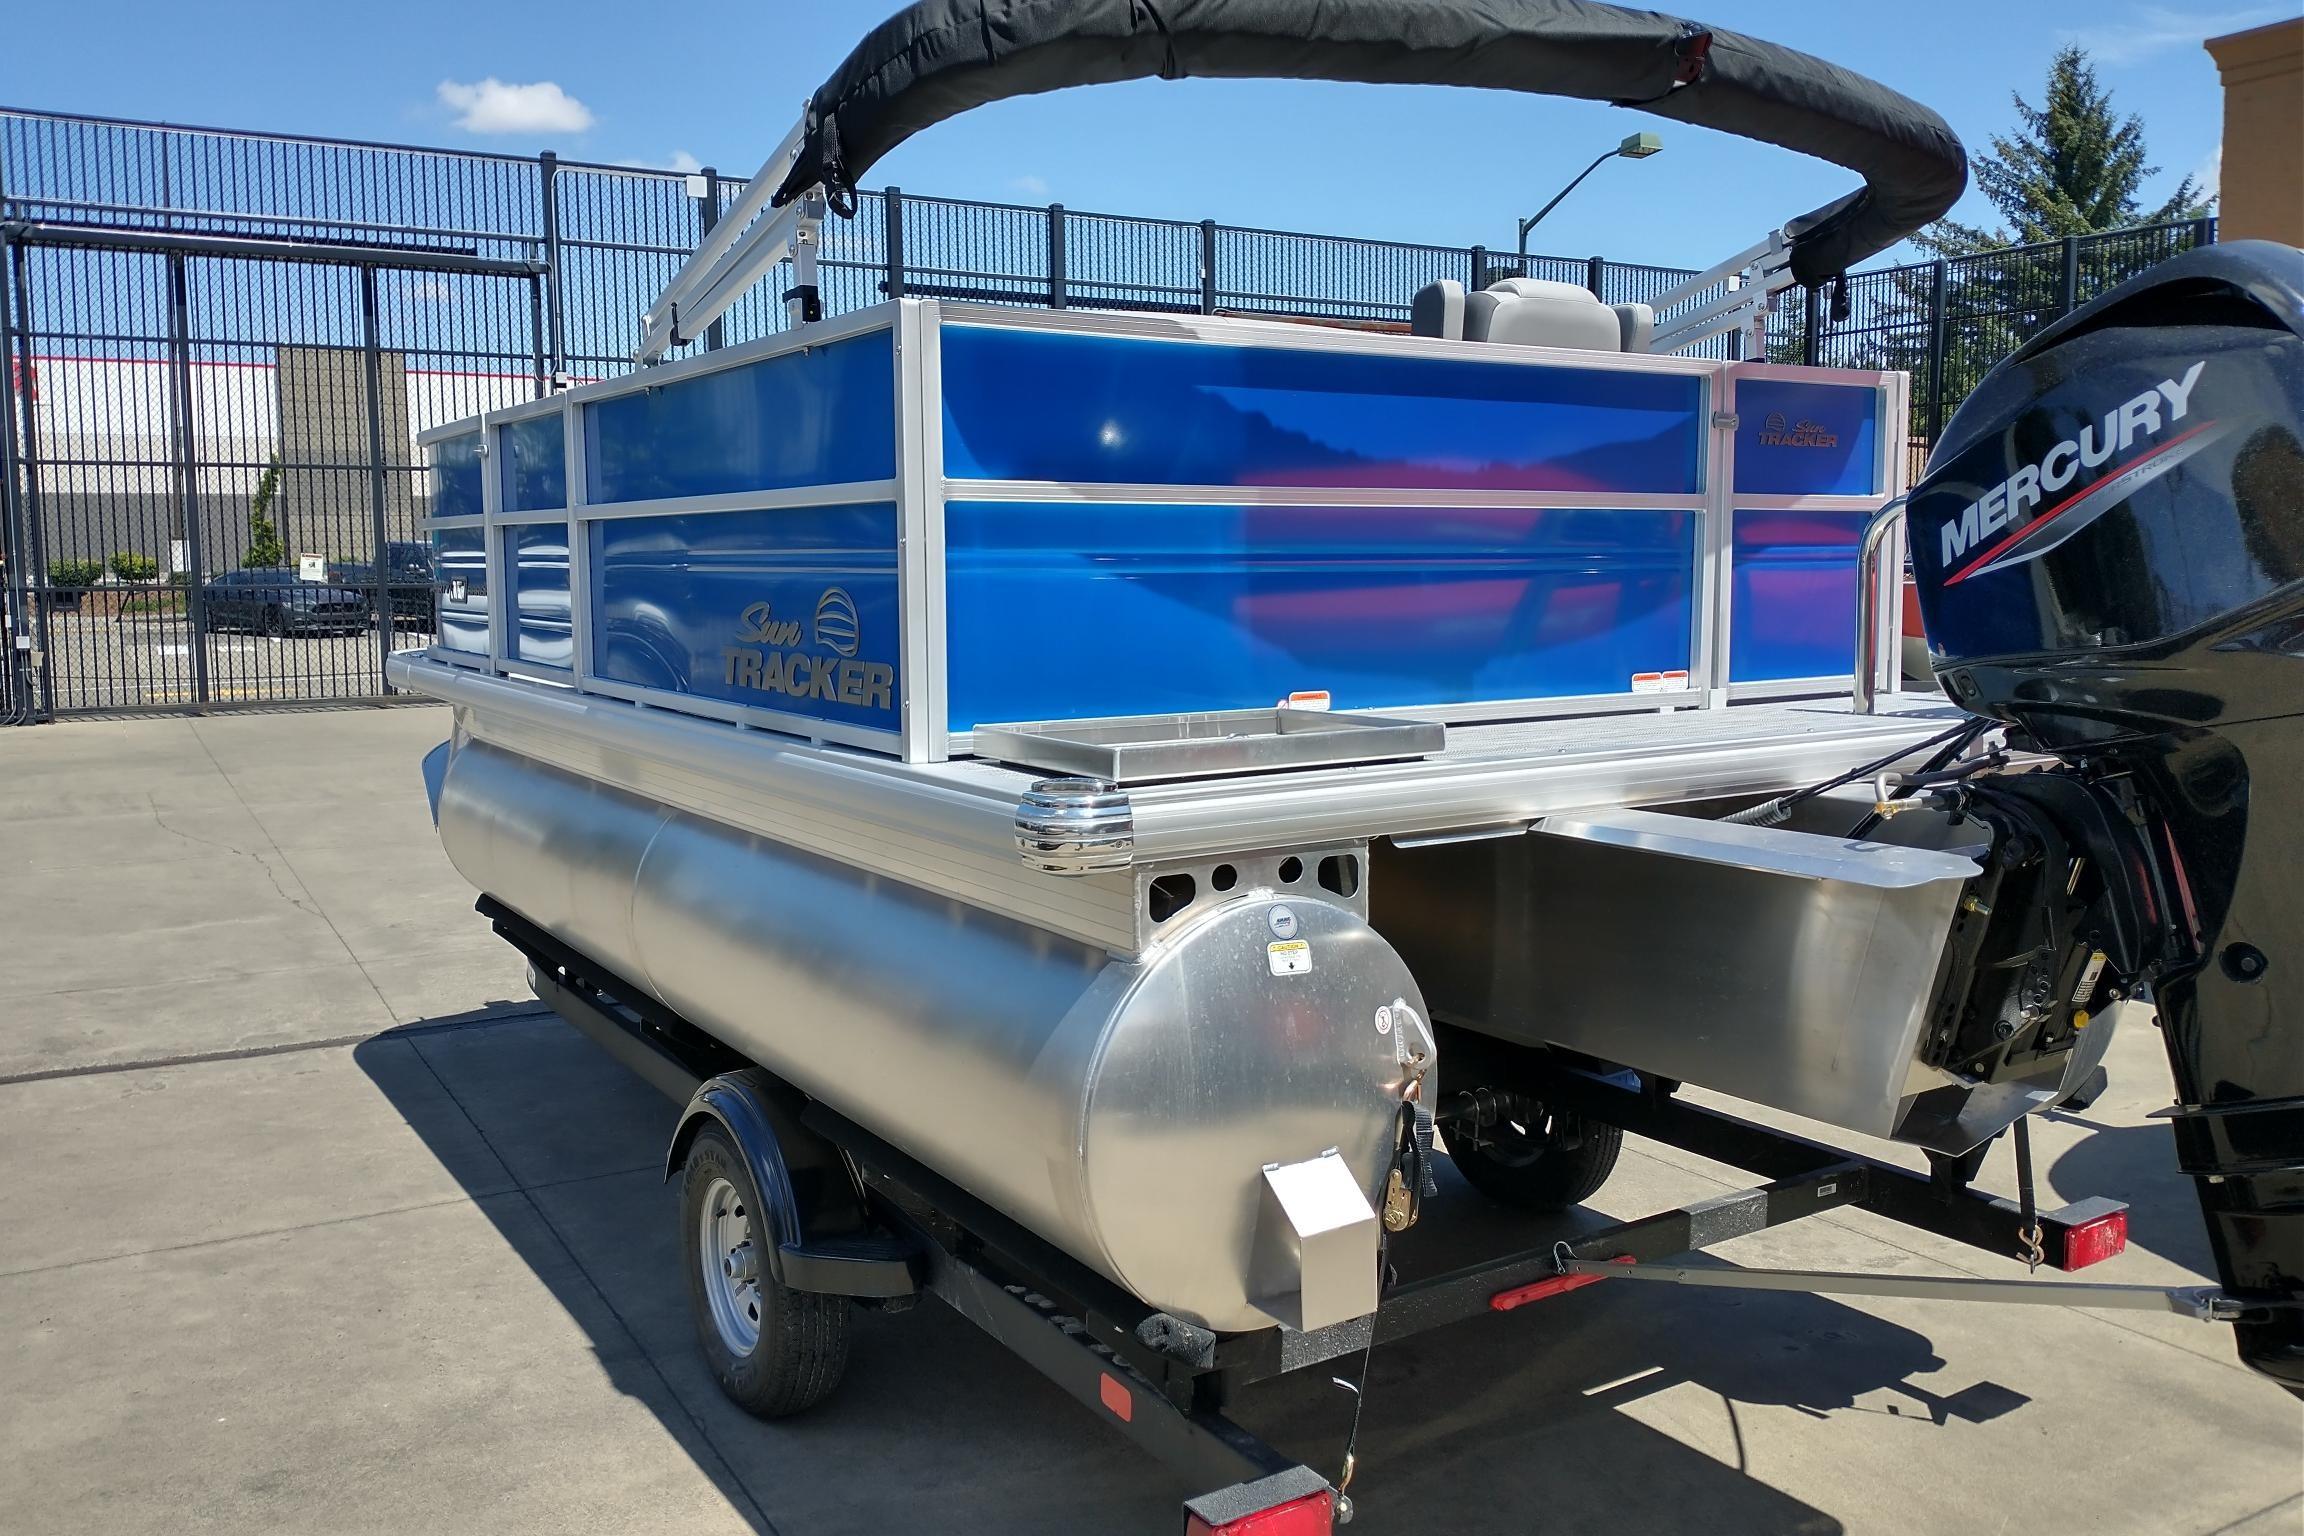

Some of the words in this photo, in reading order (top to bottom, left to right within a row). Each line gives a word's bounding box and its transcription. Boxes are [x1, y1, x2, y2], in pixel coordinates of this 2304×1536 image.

[1759, 432, 1838, 448] TRACKER
[1940, 360, 2206, 568] MERCURY
[736, 601, 802, 647] Sun
[722, 646, 893, 710] TRACKER
